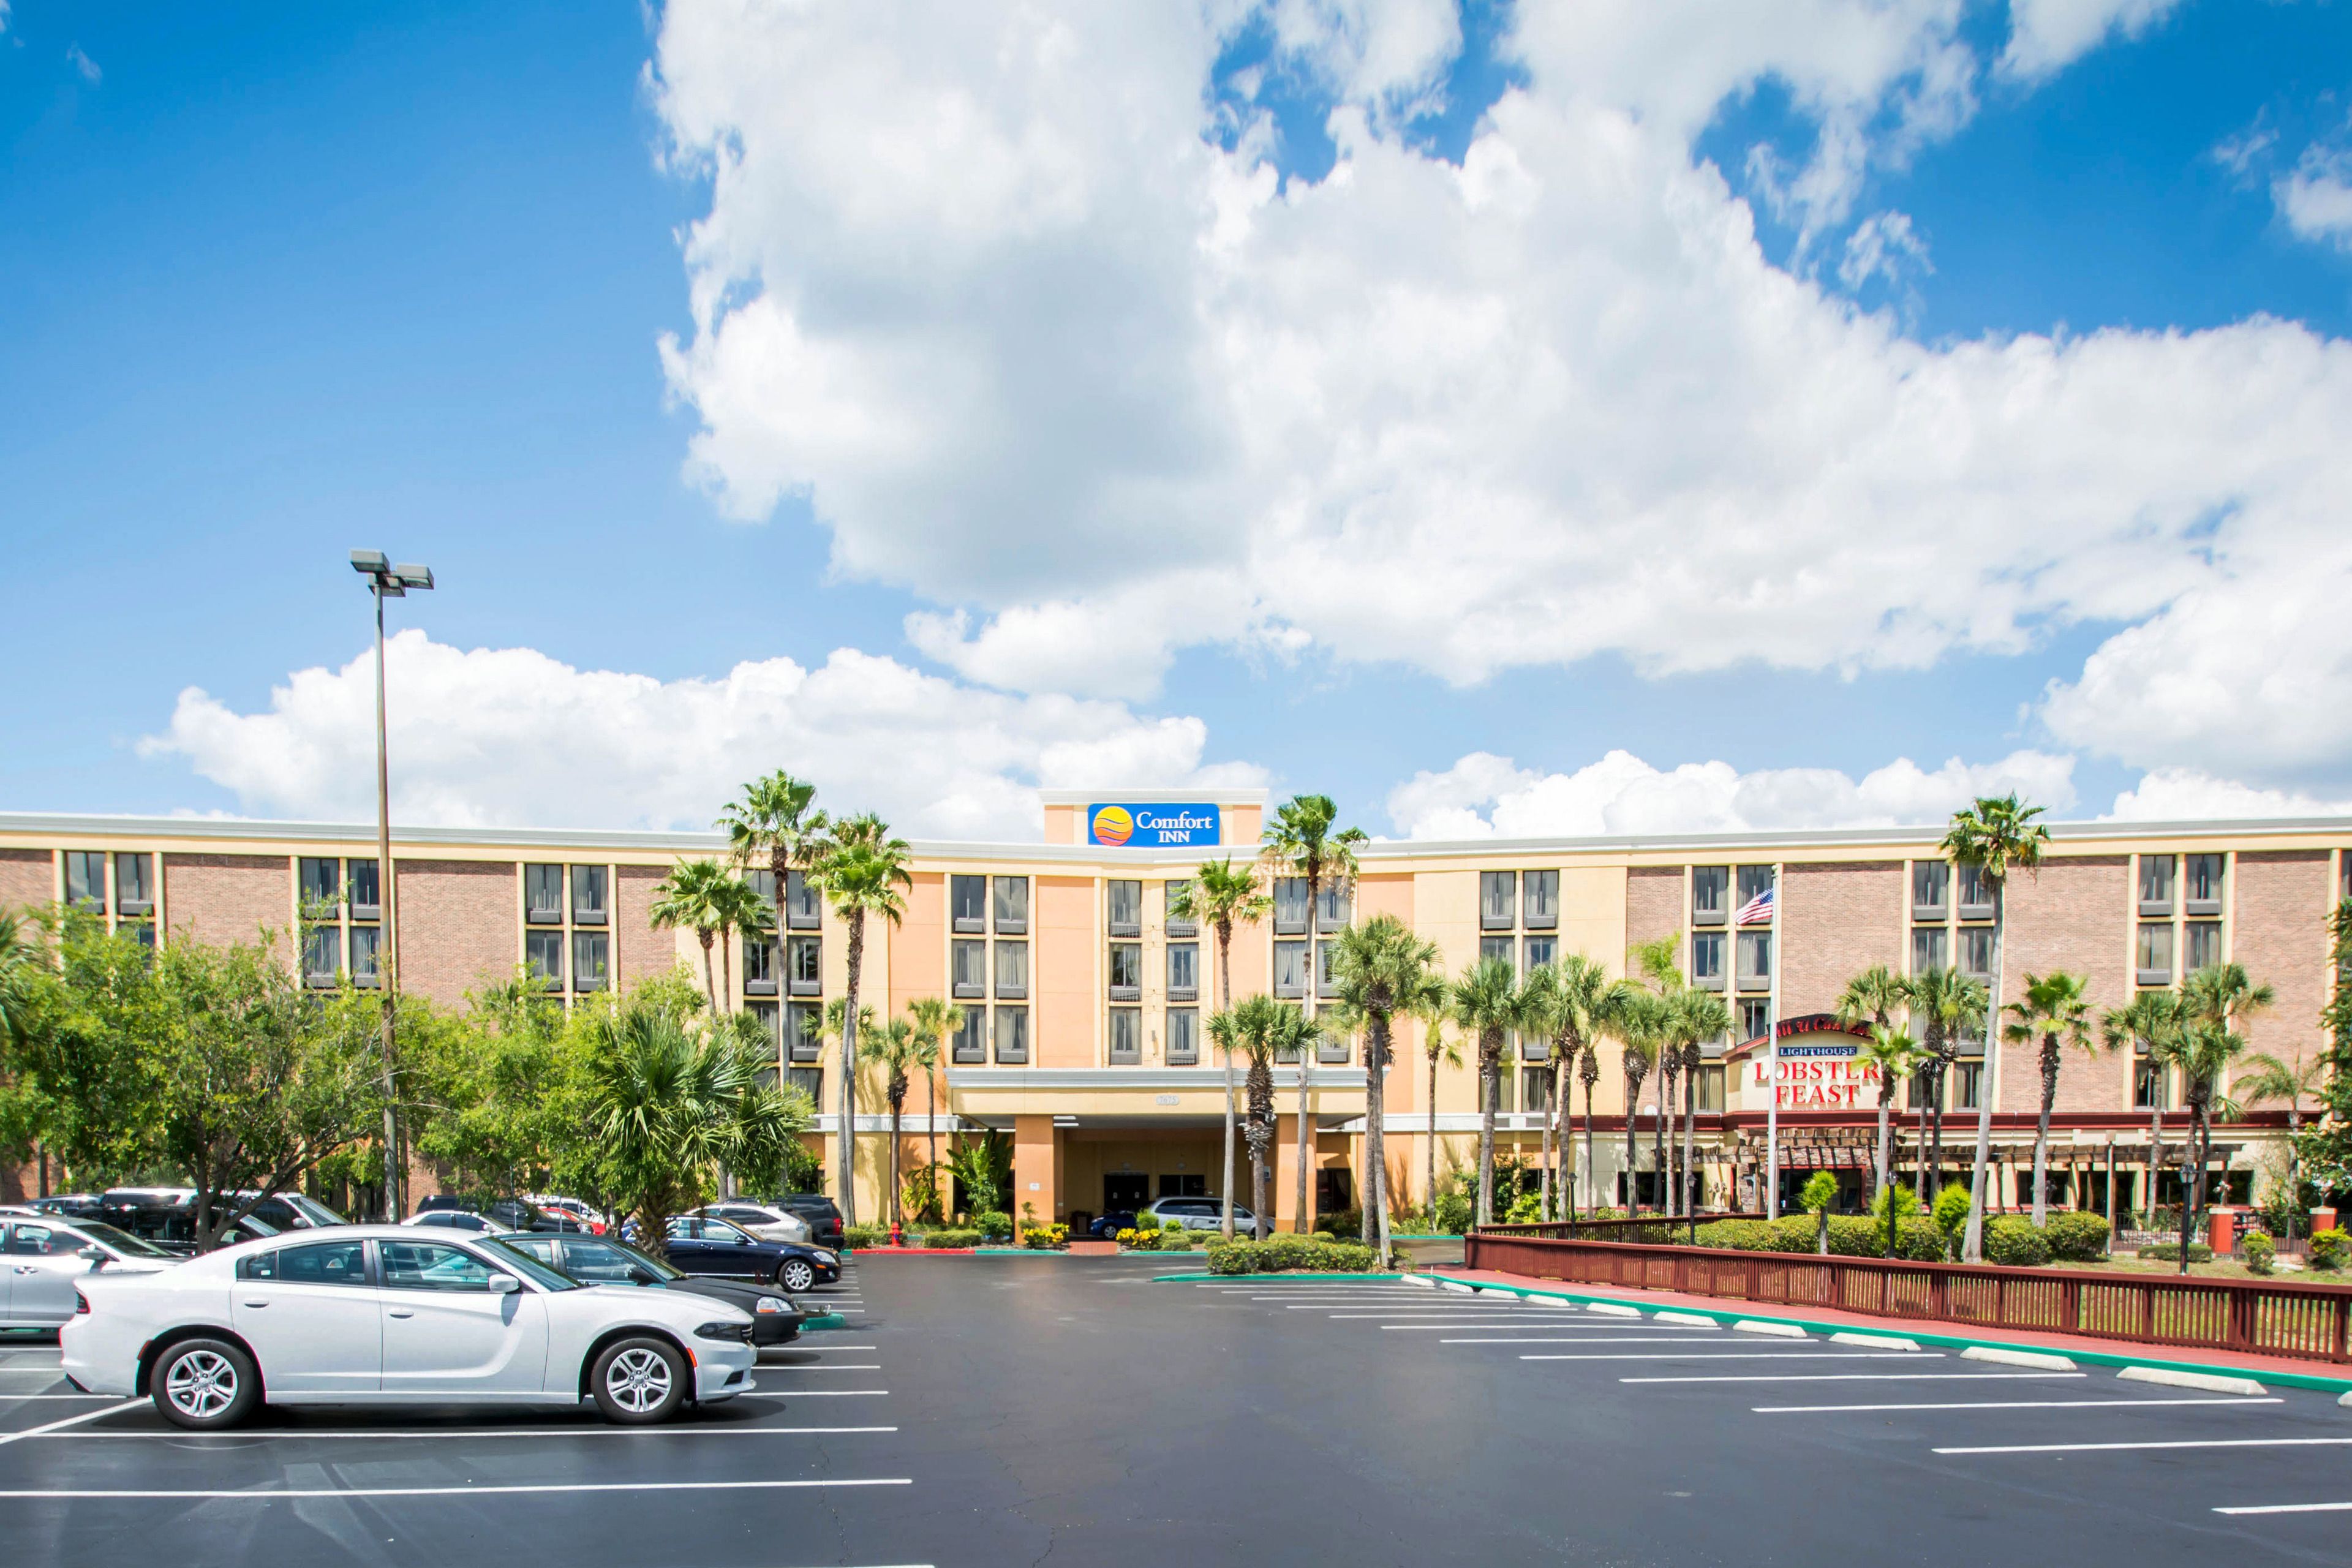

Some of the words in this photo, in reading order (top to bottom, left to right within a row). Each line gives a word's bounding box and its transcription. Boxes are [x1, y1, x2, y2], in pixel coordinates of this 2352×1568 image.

[1136, 811, 1213, 829] Comfort
[1158, 831, 1190, 843] INN
[1780, 1047, 1856, 1056] LIGHTHOUSE
[1776, 1085, 1860, 1103] FEAST
